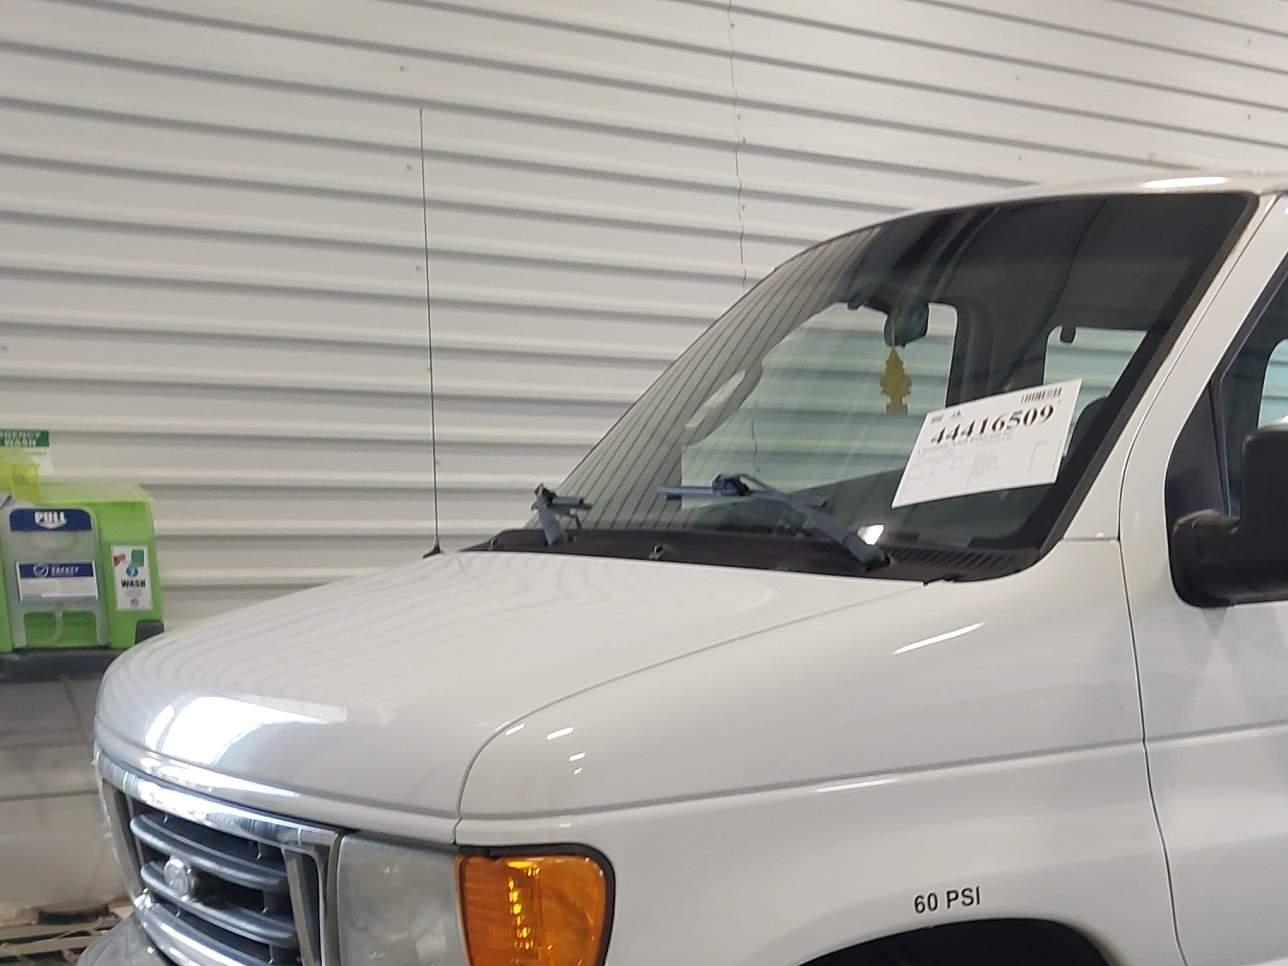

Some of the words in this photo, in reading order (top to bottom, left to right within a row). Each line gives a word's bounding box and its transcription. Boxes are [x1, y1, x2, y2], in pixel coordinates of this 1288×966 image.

[930, 405, 1054, 444] 44416509
[34, 511, 65, 523] PULL
[121, 579, 146, 588] WASH
[914, 892, 938, 914] 60
[946, 885, 980, 909] PSI
